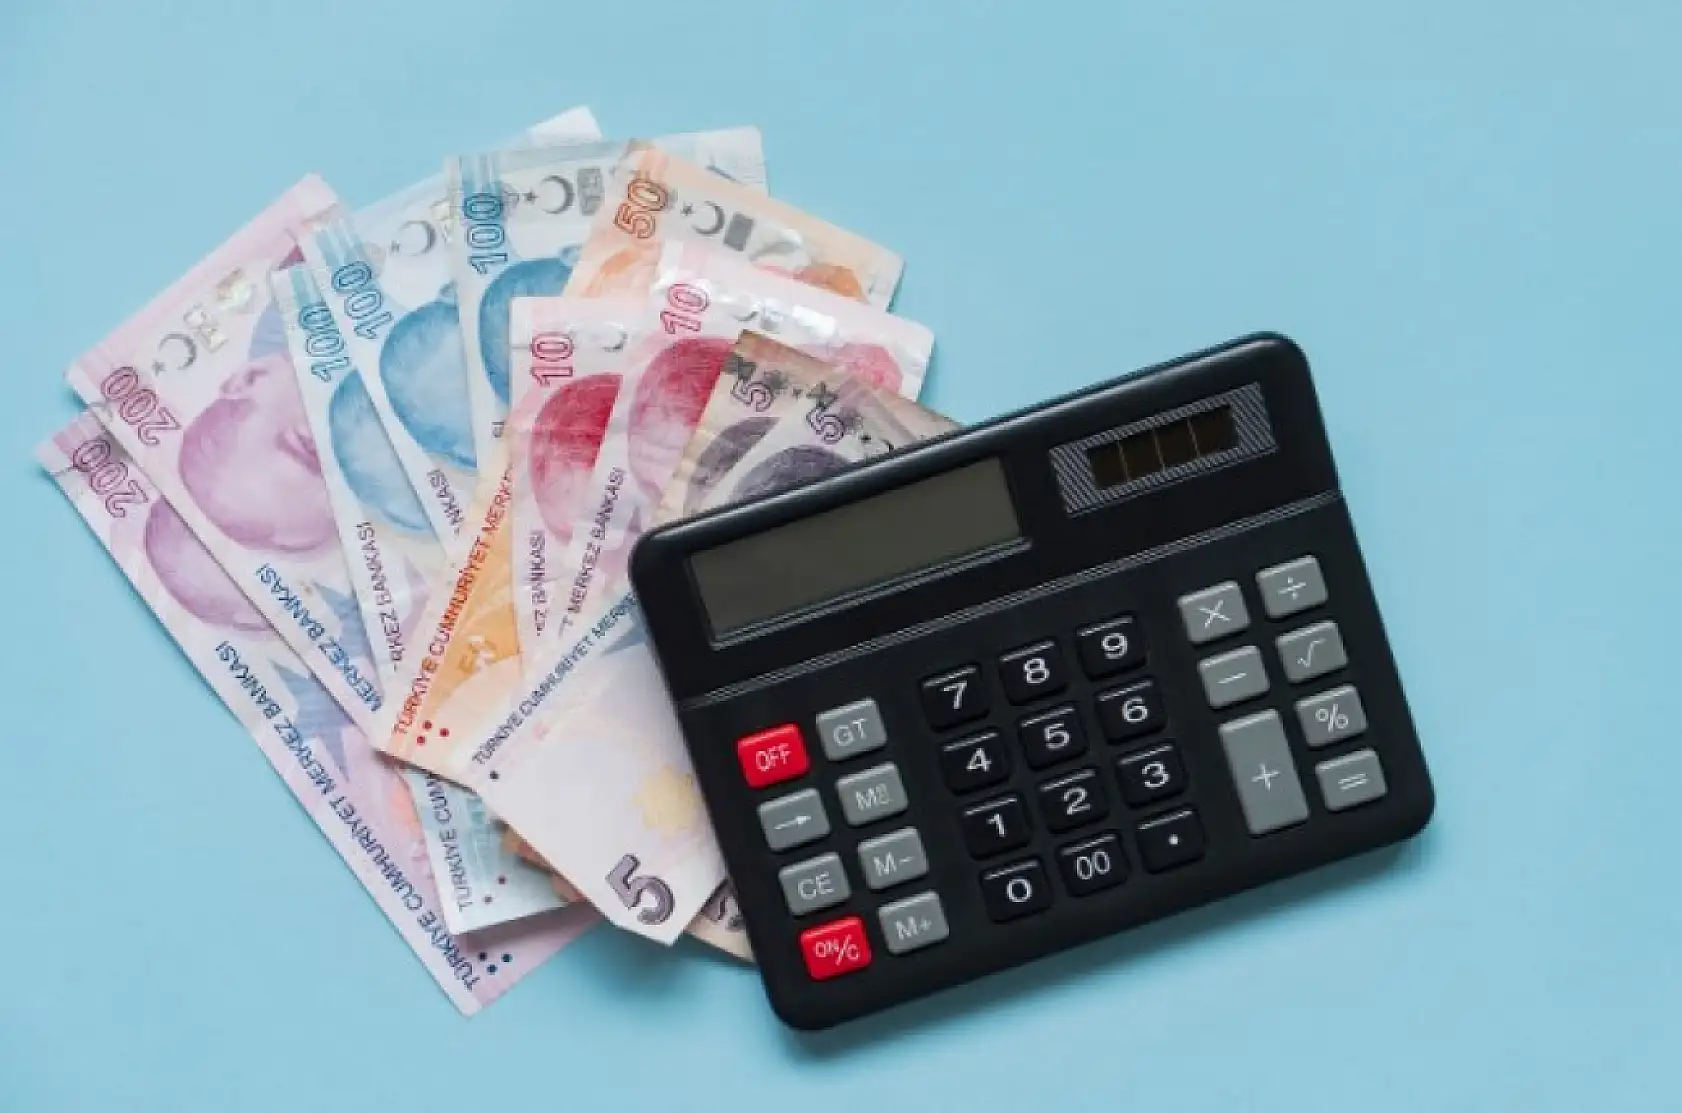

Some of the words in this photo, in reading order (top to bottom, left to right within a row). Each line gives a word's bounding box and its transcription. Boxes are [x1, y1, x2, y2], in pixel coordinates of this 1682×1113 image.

[614, 178, 668, 239] 50
[464, 193, 508, 275] 100
[331, 261, 393, 340] 100
[660, 283, 710, 335] 10
[299, 302, 349, 383] 100
[531, 333, 573, 386] 10
[101, 366, 181, 446] 200
[730, 380, 774, 412] 5
[806, 404, 847, 445] 5
[72, 439, 149, 518] 200
[356, 521, 393, 606] BANKASI
[255, 563, 325, 641] BANKASI
[1100, 632, 1128, 659] 9
[215, 640, 283, 720] BANKASI
[317, 636, 383, 712] MERKEZ
[1023, 658, 1050, 684] 8
[942, 680, 967, 710] 7
[1121, 696, 1148, 723] 6
[833, 718, 868, 747] GT
[1315, 703, 1349, 733] %
[1043, 722, 1070, 750] 5
[274, 716, 336, 795] MERKEZ
[755, 742, 792, 772] OFF
[966, 747, 992, 772] 4
[1141, 760, 1171, 788] 3
[426, 773, 452, 825] CUM
[1062, 786, 1092, 815] 2
[986, 812, 1006, 838] 1
[1075, 850, 1111, 880] 00
[605, 852, 676, 926] 5
[797, 870, 834, 900] CE
[1006, 878, 1033, 903] 0
[894, 915, 933, 940] M+
